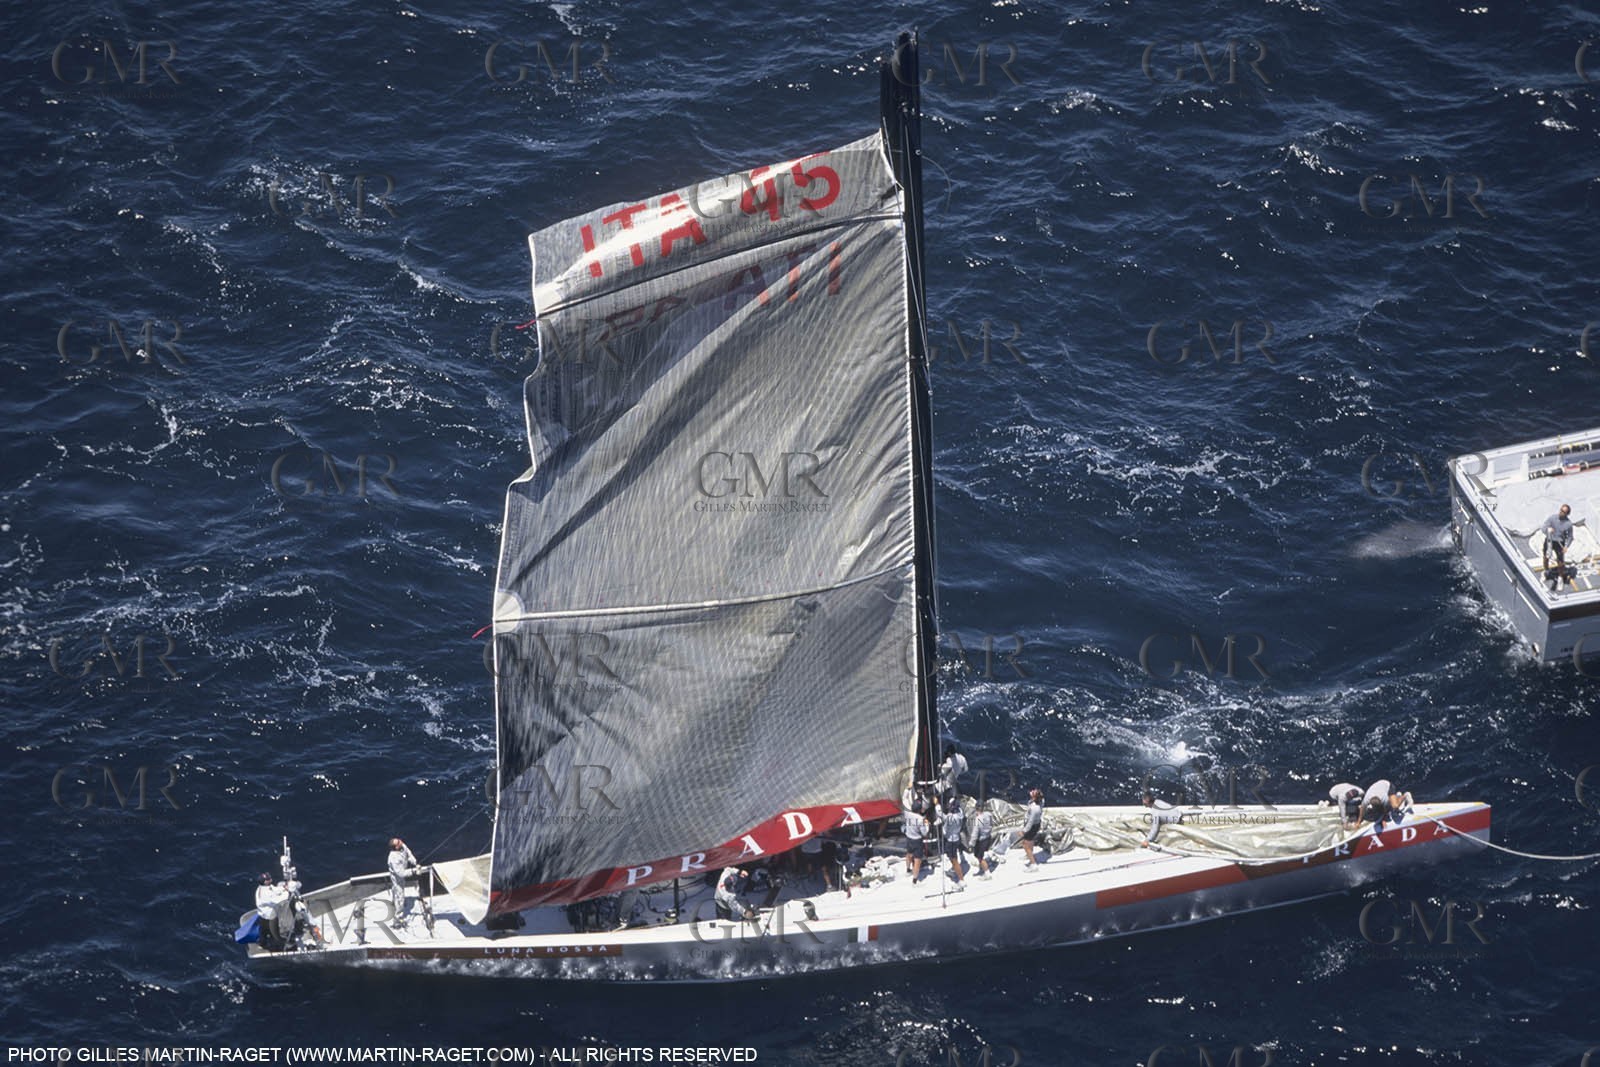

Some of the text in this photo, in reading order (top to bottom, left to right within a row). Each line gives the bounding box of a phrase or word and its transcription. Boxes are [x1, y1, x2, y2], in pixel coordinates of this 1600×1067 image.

[740, 151, 841, 222] 45
[626, 806, 863, 886] PRADA
[484, 945, 608, 955] LUNA ROSSA
